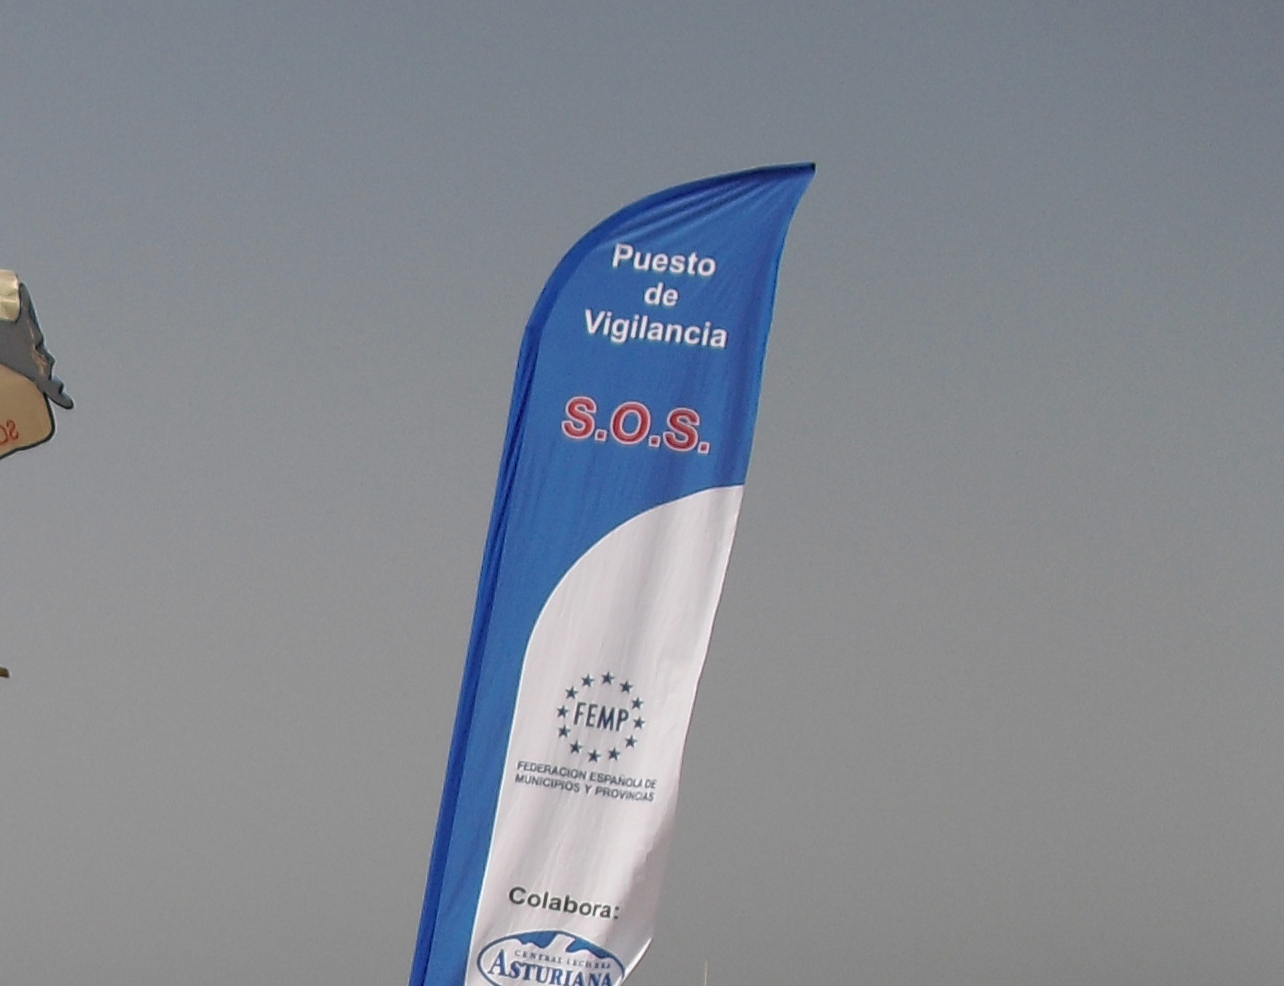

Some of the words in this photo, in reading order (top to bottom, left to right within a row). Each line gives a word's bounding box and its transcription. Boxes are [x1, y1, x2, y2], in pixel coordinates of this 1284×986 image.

[611, 243, 716, 277] Puesto
[643, 282, 679, 307] de
[583, 308, 728, 349] Vigilancia
[561, 395, 711, 455] S.O.S.
[573, 701, 630, 733] FEMP
[514, 773, 581, 794] MUNICIPIOS
[584, 784, 593, 795] Y
[516, 760, 587, 781] FEDERACION
[644, 778, 658, 789] DE
[508, 885, 621, 920] Colabora:
